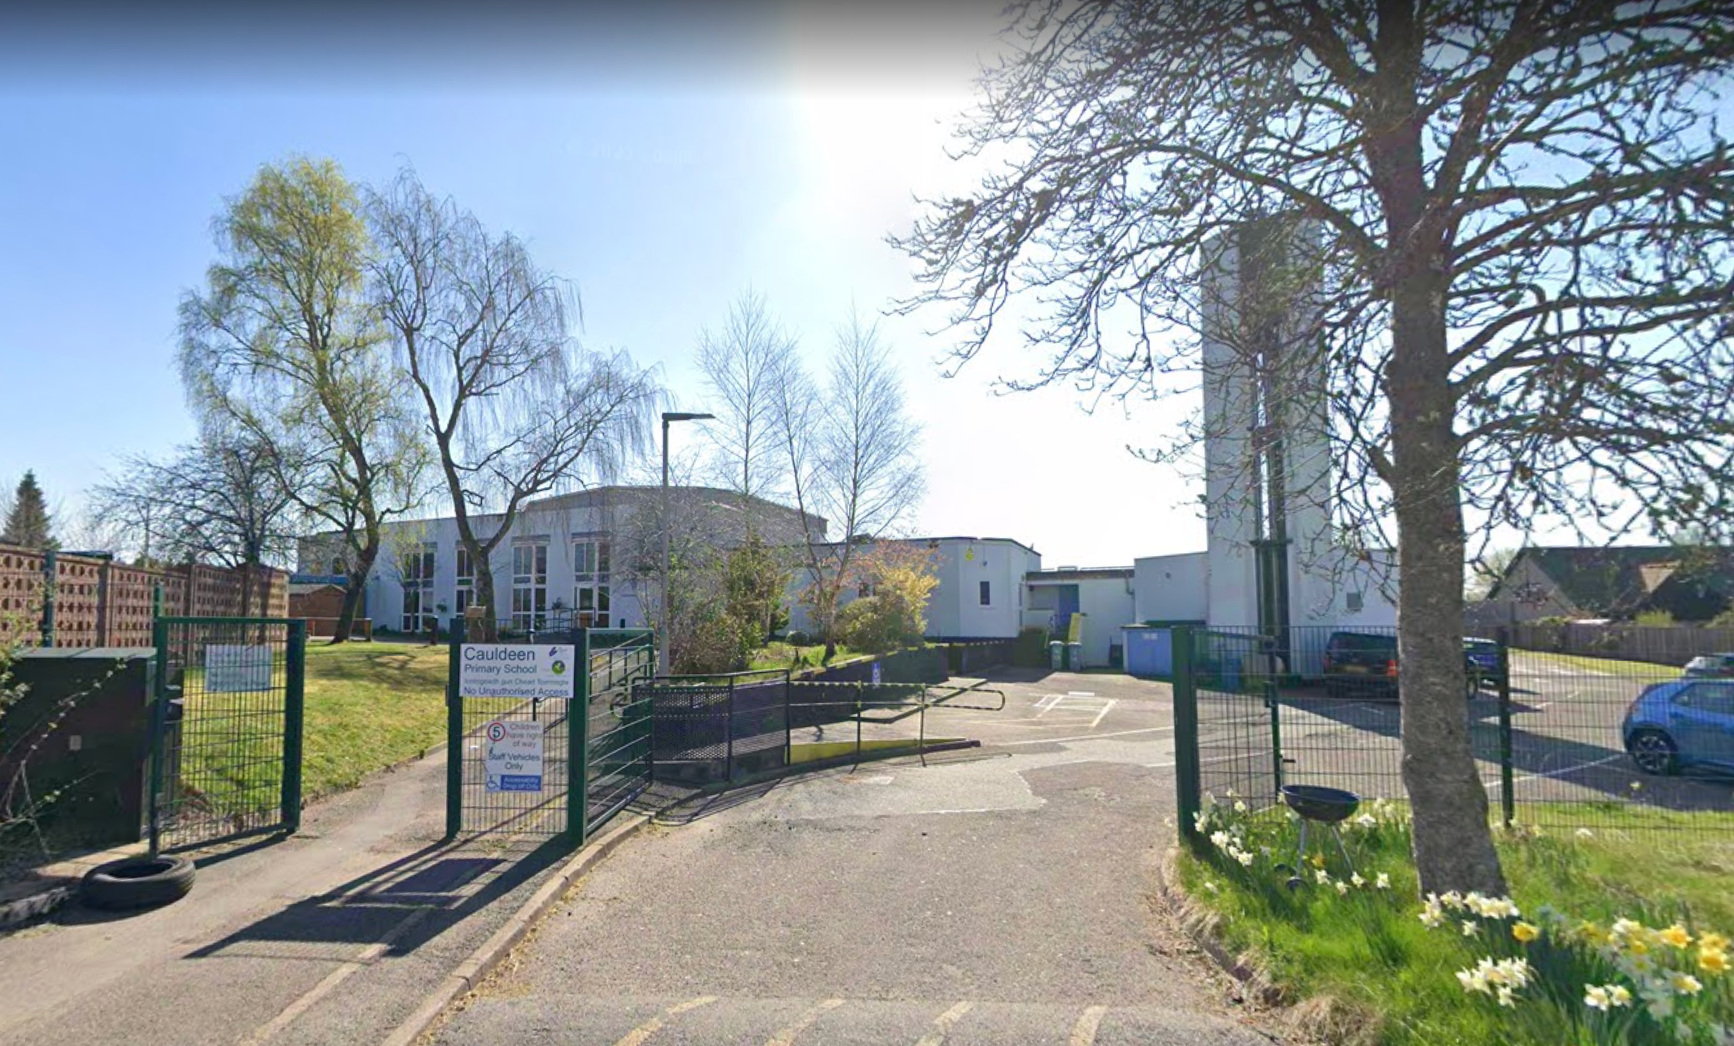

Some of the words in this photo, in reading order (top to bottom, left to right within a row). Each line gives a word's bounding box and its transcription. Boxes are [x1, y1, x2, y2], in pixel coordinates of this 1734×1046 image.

[464, 646, 535, 661] Cauldeen
[464, 664, 502, 675] Primary
[504, 664, 538, 674] School
[464, 687, 477, 695] No
[478, 687, 536, 697] Unauthorised
[538, 687, 569, 696] Access
[493, 726, 501, 738] 5
[522, 741, 537, 749] way
[507, 753, 541, 761] Vehicles
[504, 761, 524, 772] Only
